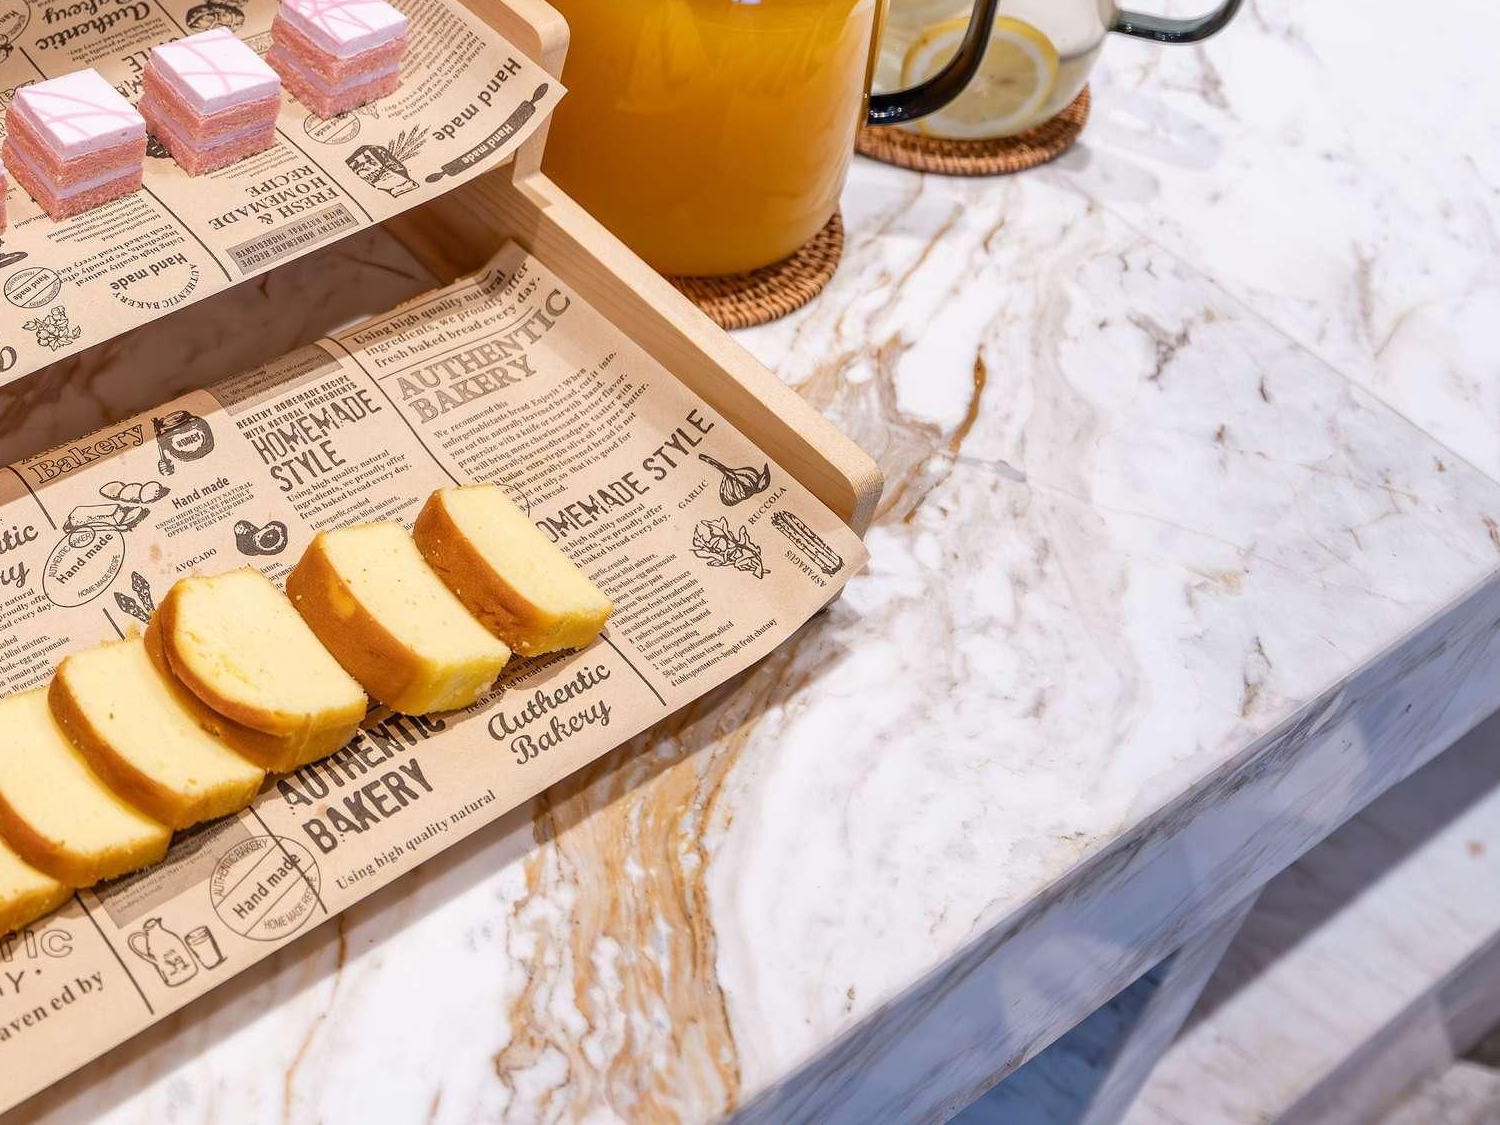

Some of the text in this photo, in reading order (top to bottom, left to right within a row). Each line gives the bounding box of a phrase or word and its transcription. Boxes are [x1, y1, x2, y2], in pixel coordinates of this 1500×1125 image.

[35, 1, 150, 51] Authentic
[432, 57, 522, 142] Hand made
[208, 177, 328, 230] HOMEMADE
[245, 165, 315, 198] RECIPE
[257, 187, 340, 225] FRESH &
[109, 252, 188, 290] Hand made
[111, 264, 200, 310] AUTHENTIC BAKERY
[363, 262, 530, 357] ingredients, we proudly offer
[373, 276, 542, 369] fresh baked bread every day.
[391, 313, 420, 331] high
[421, 298, 463, 320] quality
[463, 269, 507, 303] natural
[396, 288, 571, 401] AUTHENTIC
[242, 424, 267, 441] WITH
[267, 408, 305, 430] NATURAL
[304, 382, 359, 411] INGREDIENTS
[272, 387, 320, 413] HOMEMADE
[319, 374, 351, 396] RECIPE
[408, 355, 538, 425] BAKERY
[622, 383, 650, 409] butter.
[27, 424, 144, 484] Bakery
[250, 388, 383, 466] HOMEMADE
[269, 439, 347, 493] STYLE
[285, 449, 390, 503] Using high quality natural
[293, 453, 407, 512] ingredients, we proudly offer
[299, 462, 413, 520] fresh baked bread every day.
[536, 408, 716, 544] OMEMADE STYLE
[172, 477, 231, 510] Hand made
[678, 479, 710, 511] GARLIC
[747, 487, 788, 526] RUCCOLA
[569, 502, 646, 550] high quality natural
[600, 504, 664, 544] we proudly offer
[57, 533, 114, 585] Hand made
[174, 548, 218, 574] AVOCADO
[784, 550, 828, 588] ASPARAGUS
[4, 588, 35, 607] natural
[487, 664, 612, 742] Authentic
[510, 699, 612, 765] Bakery
[301, 757, 434, 856] BAKERY
[335, 789, 498, 891] Using high quality natural
[232, 882, 269, 920] Hand
[266, 853, 302, 888] made
[49, 985, 77, 1012] ed
[76, 971, 105, 1001] by
